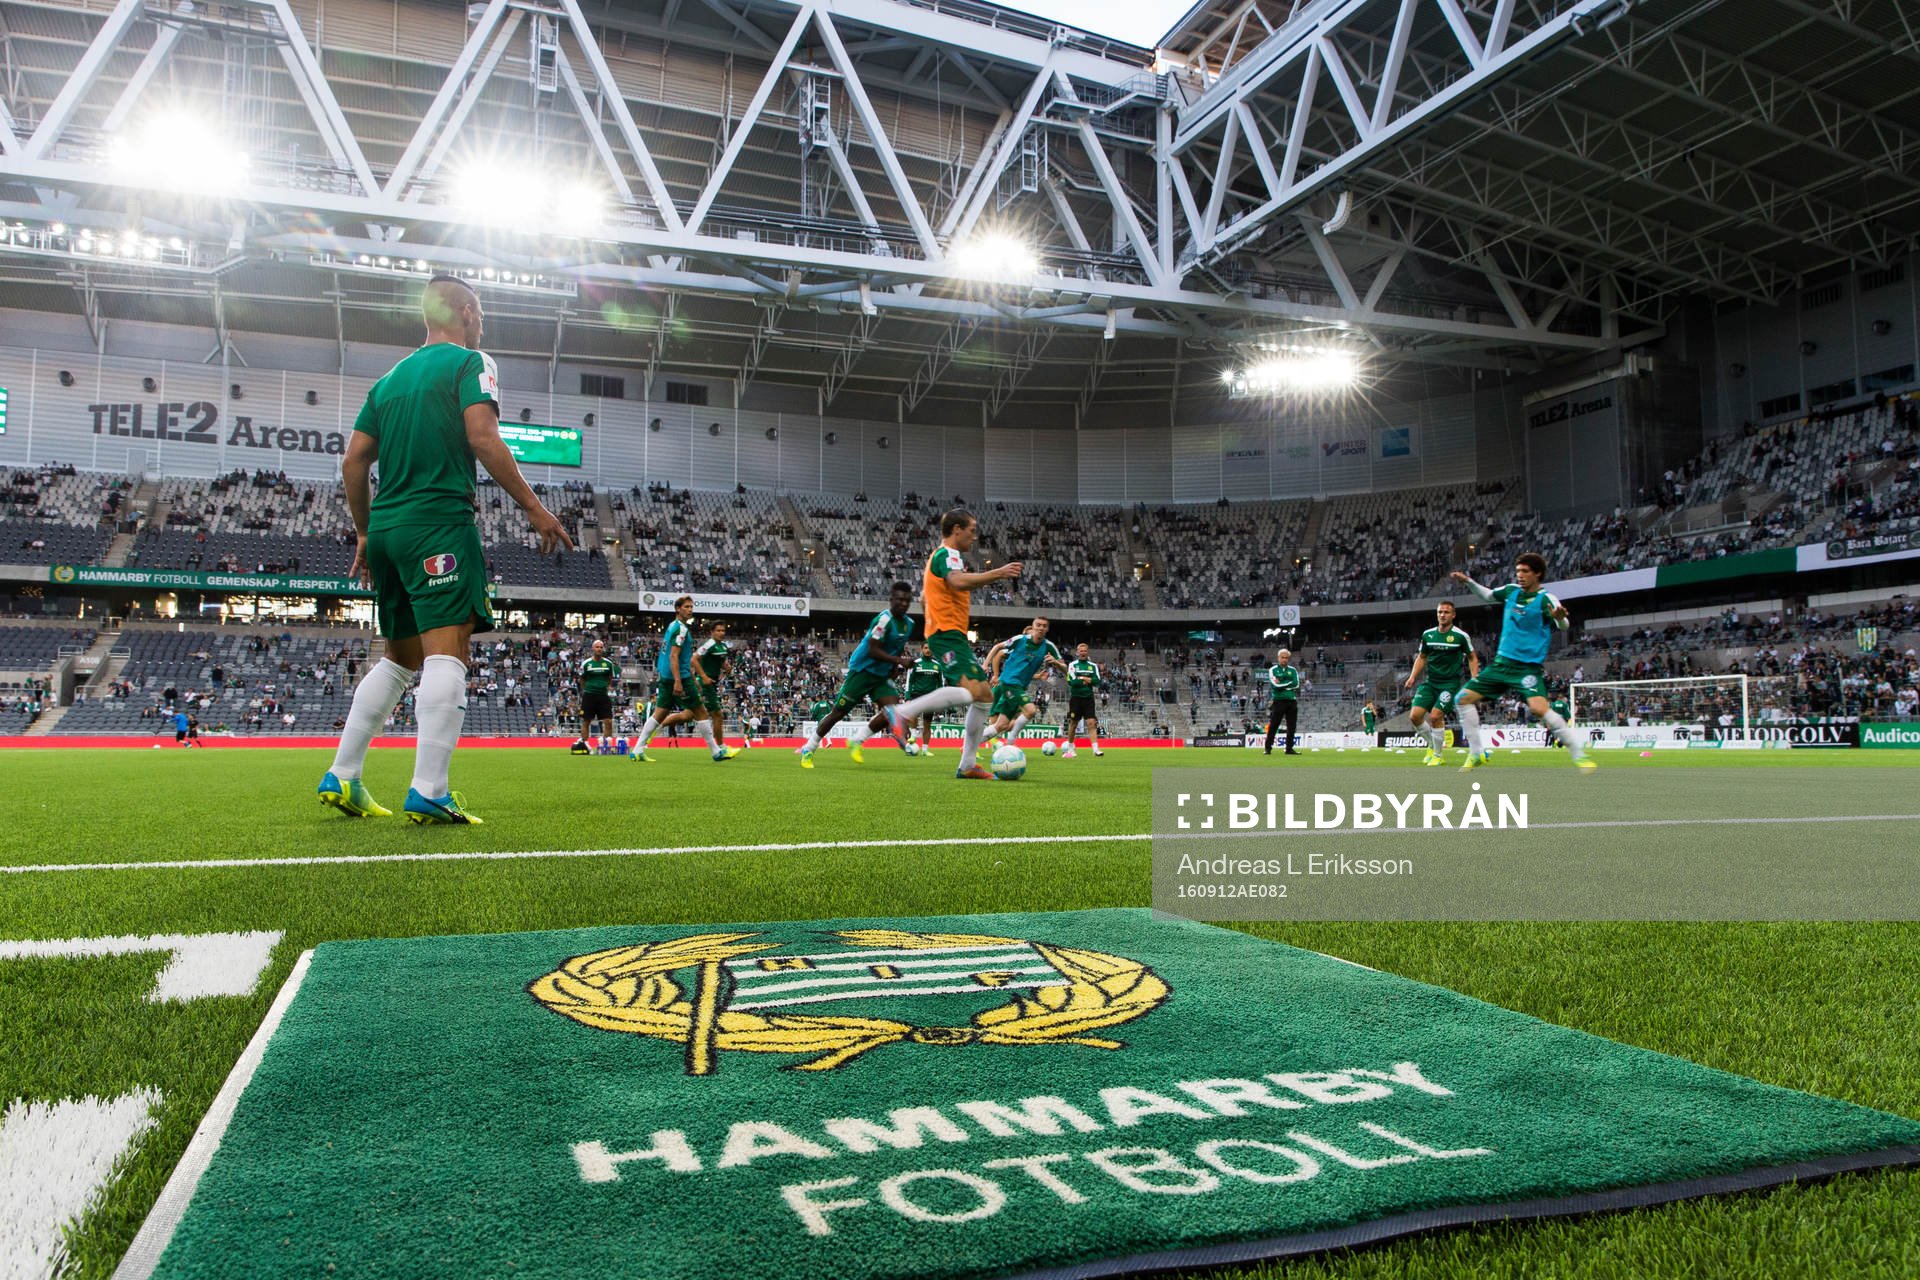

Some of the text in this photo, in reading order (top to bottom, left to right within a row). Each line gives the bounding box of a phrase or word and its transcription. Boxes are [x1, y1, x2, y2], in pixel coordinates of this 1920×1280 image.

[88, 401, 345, 455] TELE2 Arena
[1340, 439, 1367, 448] INTER
[79, 570, 152, 583] HAMMARBY
[153, 573, 201, 585] FOTBOLL
[206, 576, 280, 588] GEMENSKAP
[289, 579, 340, 591] RESPEKT
[694, 600, 719, 608] OSITIV
[721, 602, 792, 610] SUPPORTERKULTUR
[571, 1061, 1455, 1183] HAMMARBY
[779, 1121, 1496, 1236] FOTBOLL
